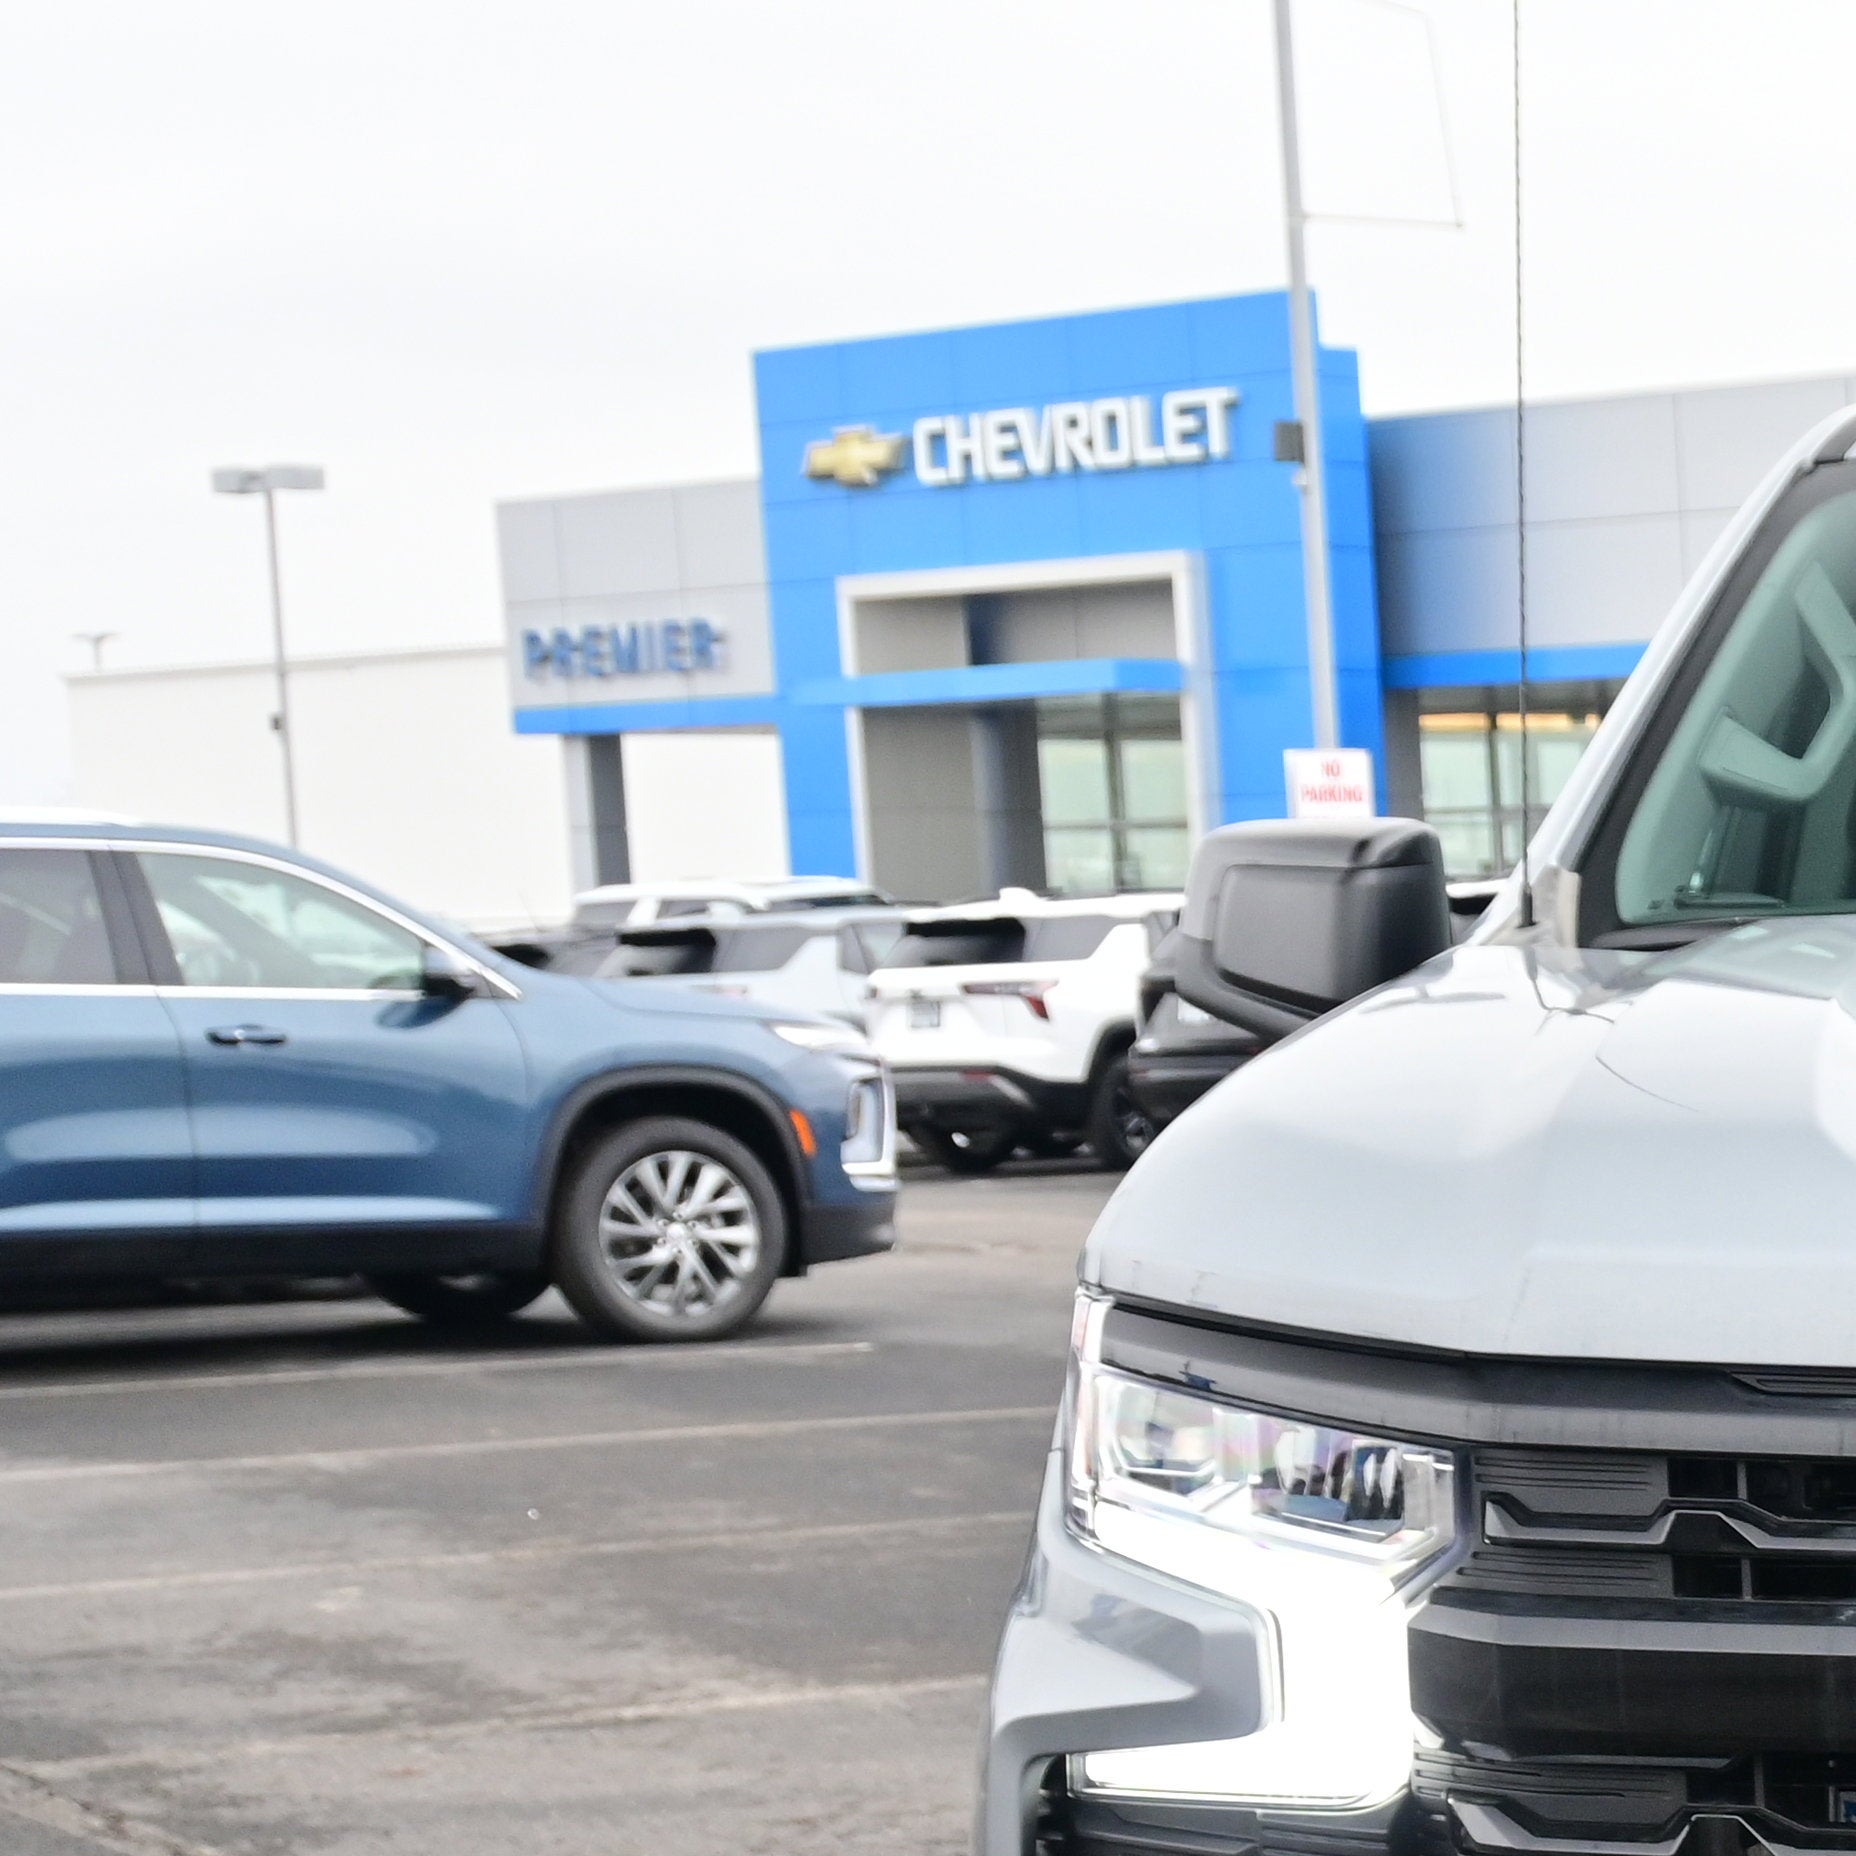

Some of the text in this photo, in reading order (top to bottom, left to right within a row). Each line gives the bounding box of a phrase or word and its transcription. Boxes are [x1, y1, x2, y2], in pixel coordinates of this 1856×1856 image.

[912, 387, 1239, 486] CHEVROLET
[522, 617, 727, 680] PREMIER
[1319, 760, 1341, 777] NO
[1301, 784, 1363, 803] PARKING
